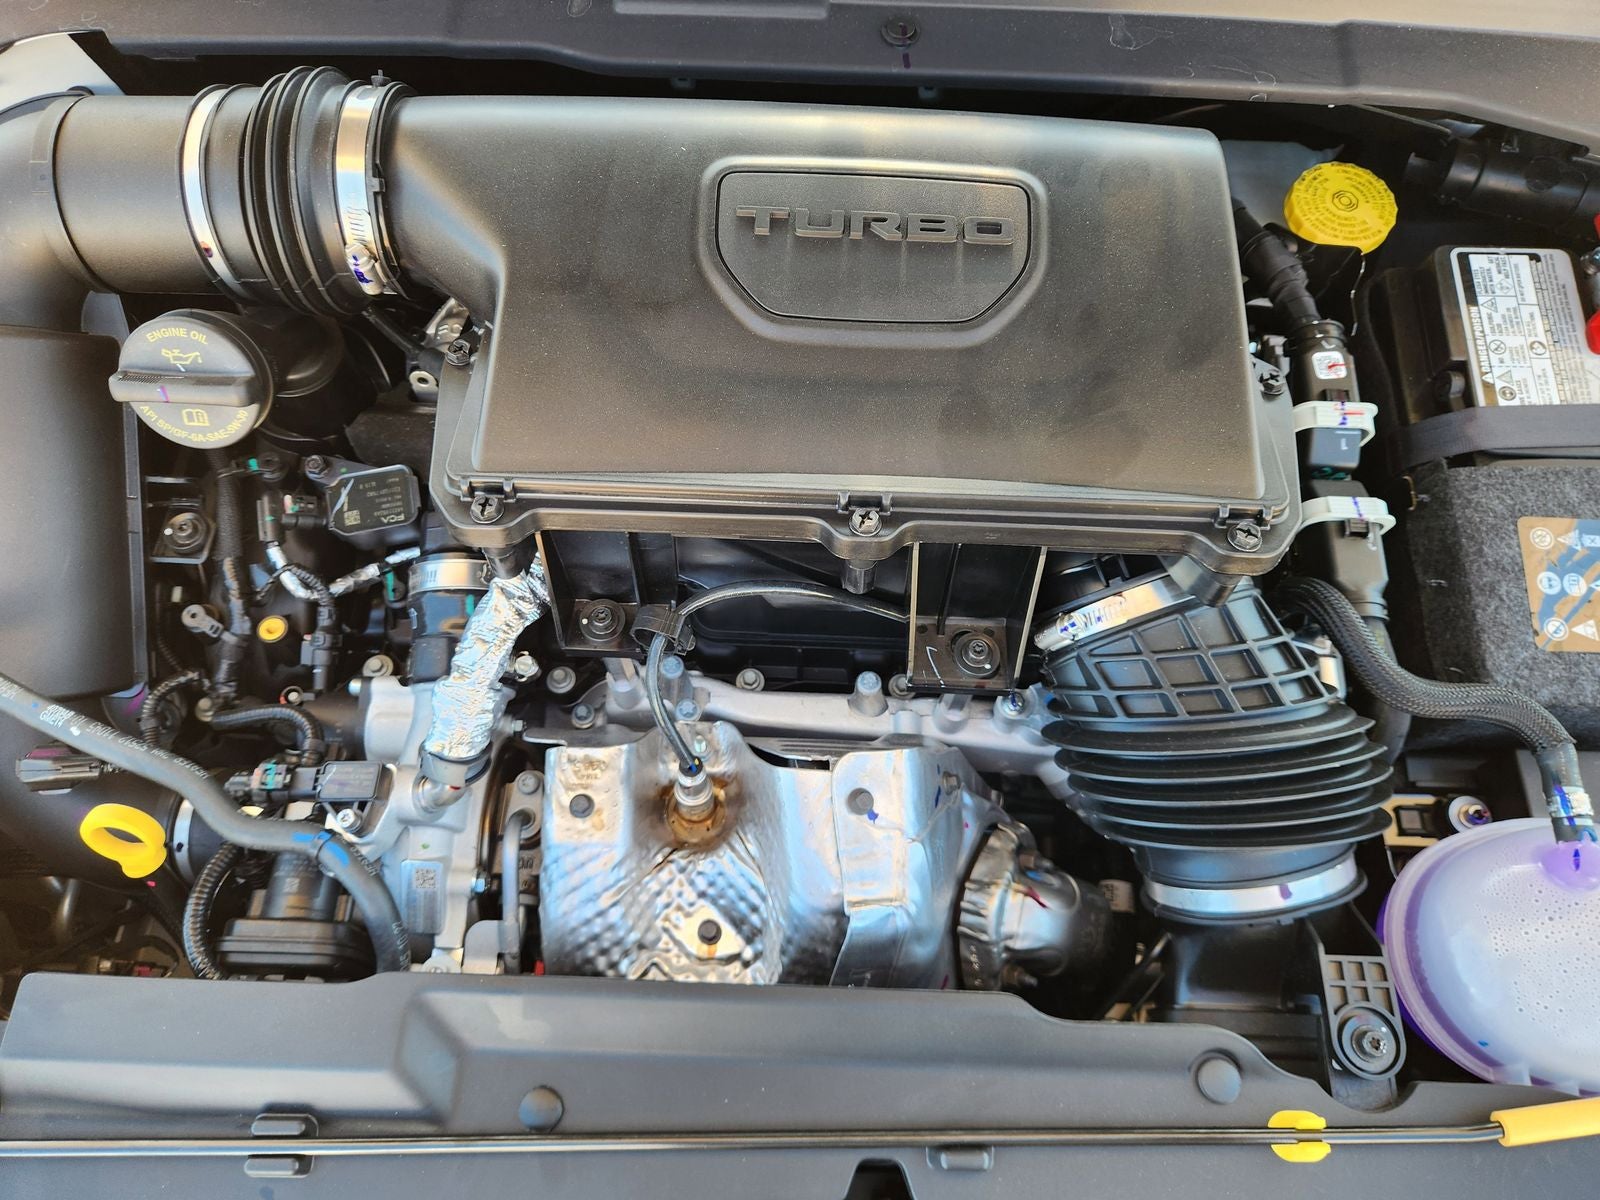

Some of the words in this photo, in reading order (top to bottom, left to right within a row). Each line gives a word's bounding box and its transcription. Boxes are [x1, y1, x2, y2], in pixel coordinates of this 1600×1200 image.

[736, 204, 1015, 246] TURBO
[146, 327, 188, 343] ENGINE
[190, 331, 208, 345] OIL
[1469, 306, 1491, 372] DANGER/POISON
[139, 405, 158, 422] API
[381, 513, 405, 524] FCA
